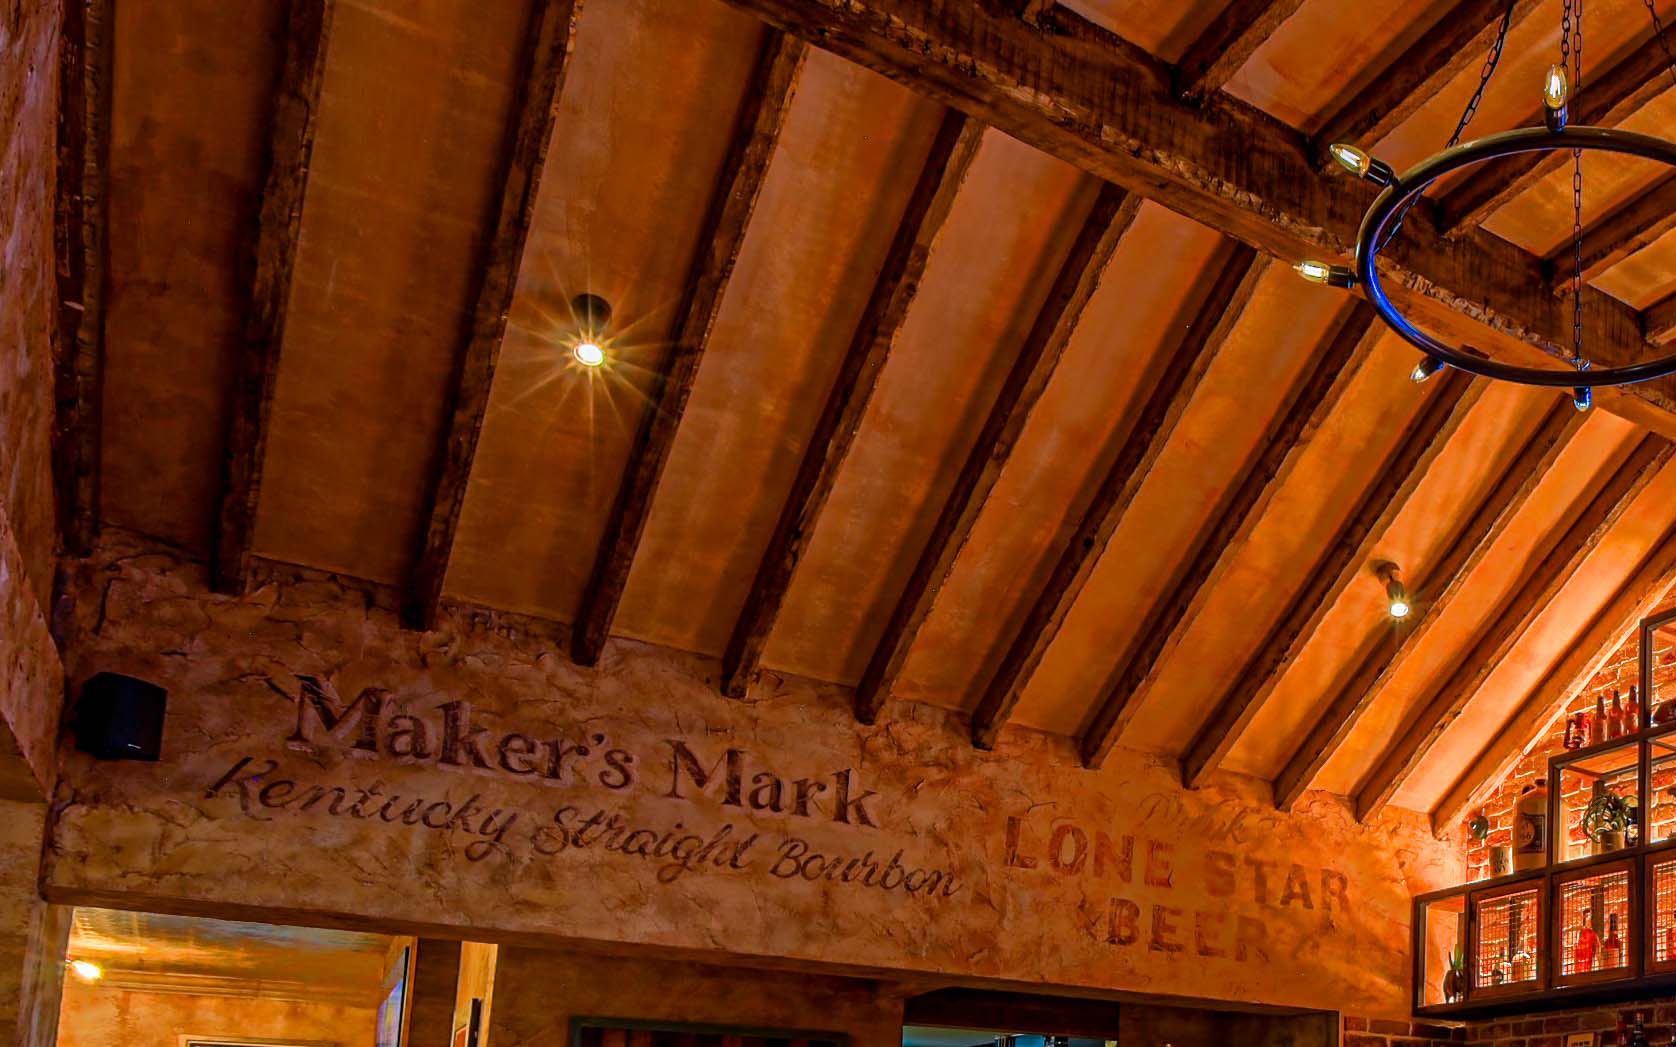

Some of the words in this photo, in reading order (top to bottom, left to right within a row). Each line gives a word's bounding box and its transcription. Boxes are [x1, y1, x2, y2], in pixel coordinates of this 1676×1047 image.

[280, 674, 634, 790] Maker's
[663, 738, 879, 830] Mark
[204, 755, 518, 862] Kentucky
[532, 806, 760, 884] Straight
[768, 836, 964, 898] Bourbon
[1002, 815, 1172, 890] LONE
[1203, 849, 1352, 912] STAR
[1106, 896, 1269, 962] BEER
